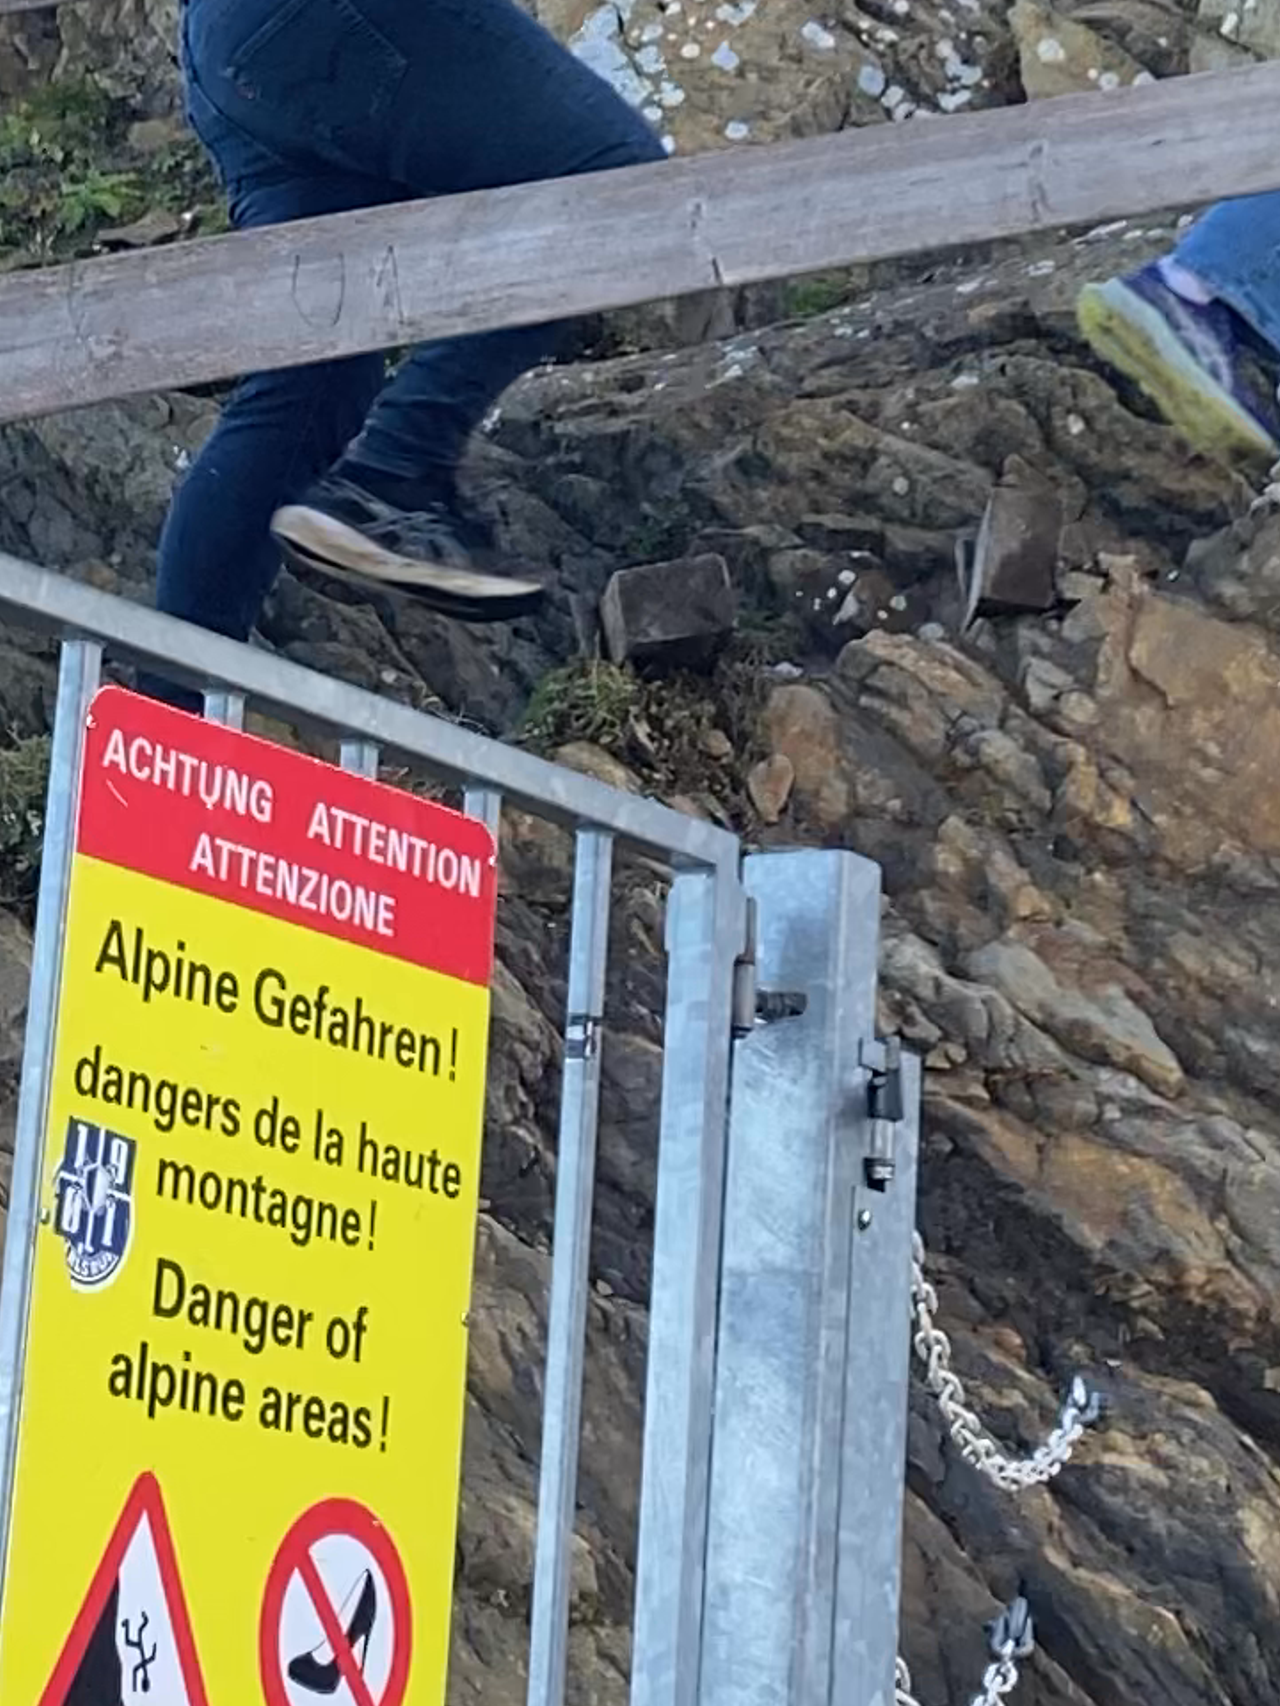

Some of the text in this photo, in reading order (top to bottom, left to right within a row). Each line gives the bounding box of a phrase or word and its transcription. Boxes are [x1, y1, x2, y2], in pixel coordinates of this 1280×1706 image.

[101, 728, 482, 898] ACHTUNG ATTENTION
[188, 833, 397, 937] ATTENZIONE
[95, 919, 459, 1083] Alpine Gefahren!
[74, 1045, 462, 1200] dangers de la haute
[156, 1156, 378, 1252] montagne!
[152, 1255, 369, 1363] Danger of
[107, 1342, 391, 1453] alpine areas!
